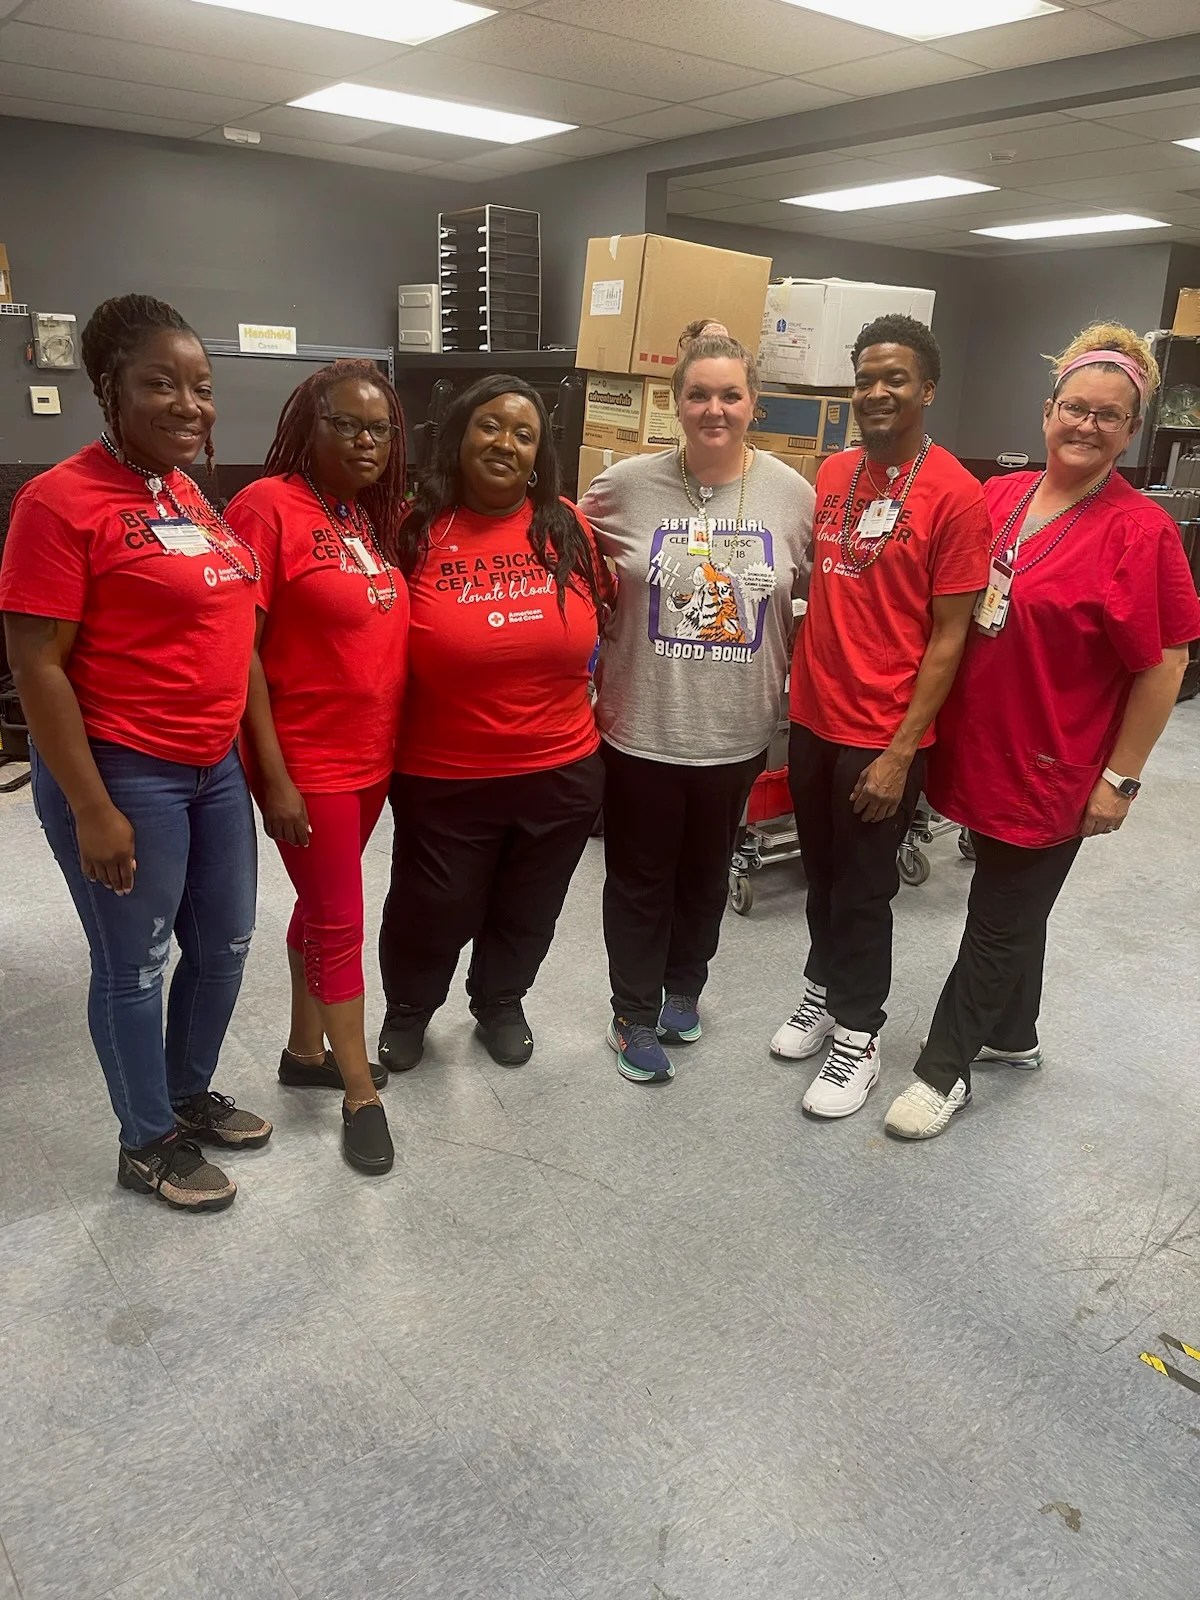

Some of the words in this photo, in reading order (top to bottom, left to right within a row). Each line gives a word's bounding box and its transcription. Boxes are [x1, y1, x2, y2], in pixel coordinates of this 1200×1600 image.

[243, 327, 291, 340] Handheld
[823, 494, 841, 509] BE
[120, 509, 150, 529] BE
[312, 528, 338, 543] BE
[440, 560, 469, 577] BE
[474, 558, 488, 572] A
[651, 550, 681, 578] ALL
[435, 575, 484, 592] CELL
[645, 565, 676, 590] IN!
[457, 581, 507, 604] donate
[508, 573, 556, 599] blood
[508, 609, 543, 617] American
[508, 615, 523, 623] Red
[523, 613, 544, 621] Cross
[654, 640, 705, 661] BLOOD
[711, 646, 755, 664] BOWL
